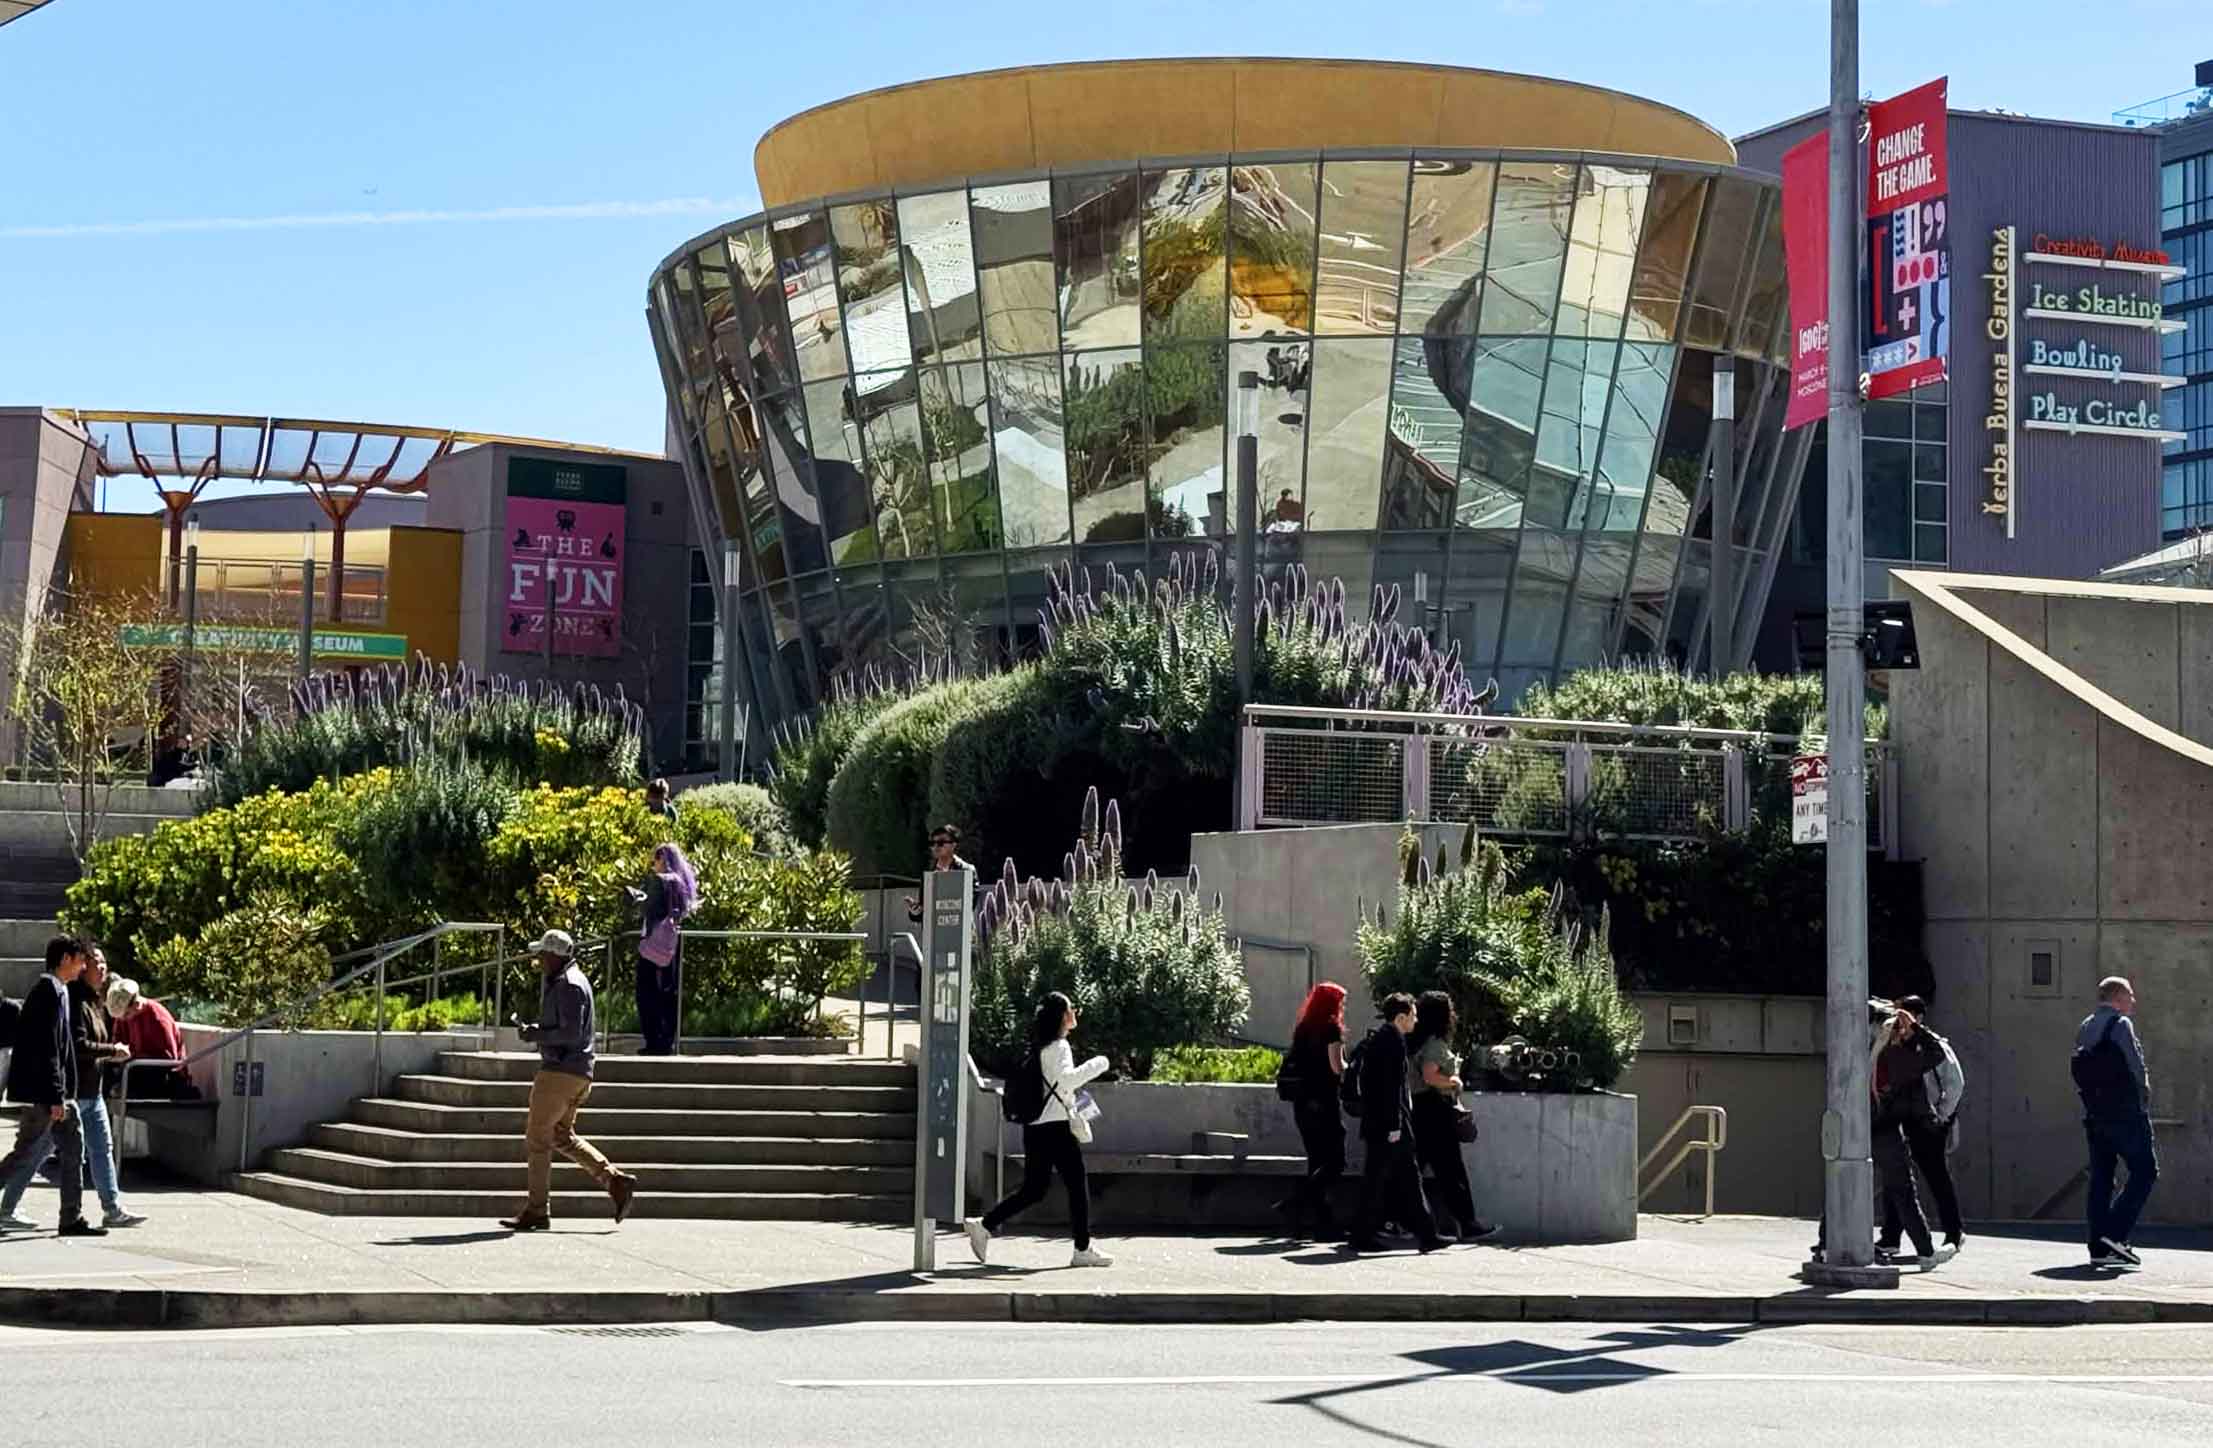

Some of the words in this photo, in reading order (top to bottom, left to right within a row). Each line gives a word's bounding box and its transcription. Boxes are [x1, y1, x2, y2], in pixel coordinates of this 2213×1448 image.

[1877, 123, 1925, 168] CHANGE
[1876, 166, 1899, 201] THE
[1899, 154, 1936, 194] GAME.
[2032, 233, 2107, 259] Creativity
[1981, 227, 2008, 340] Gardens
[2031, 284, 2069, 310] Ice
[2079, 284, 2163, 330] Skating
[2031, 339, 2123, 384] Bowling
[1987, 353, 2009, 430] Buena
[2031, 392, 2078, 435] Play
[2086, 399, 2161, 428] Circle
[1982, 443, 2008, 514] Yerba
[536, 534, 594, 557] THE
[509, 562, 617, 607] FUN
[170, 629, 280, 649] CEATIVITY
[283, 634, 364, 652] MSEUM
[1796, 801, 1809, 817] ANY
[1812, 801, 1826, 816] TIM
